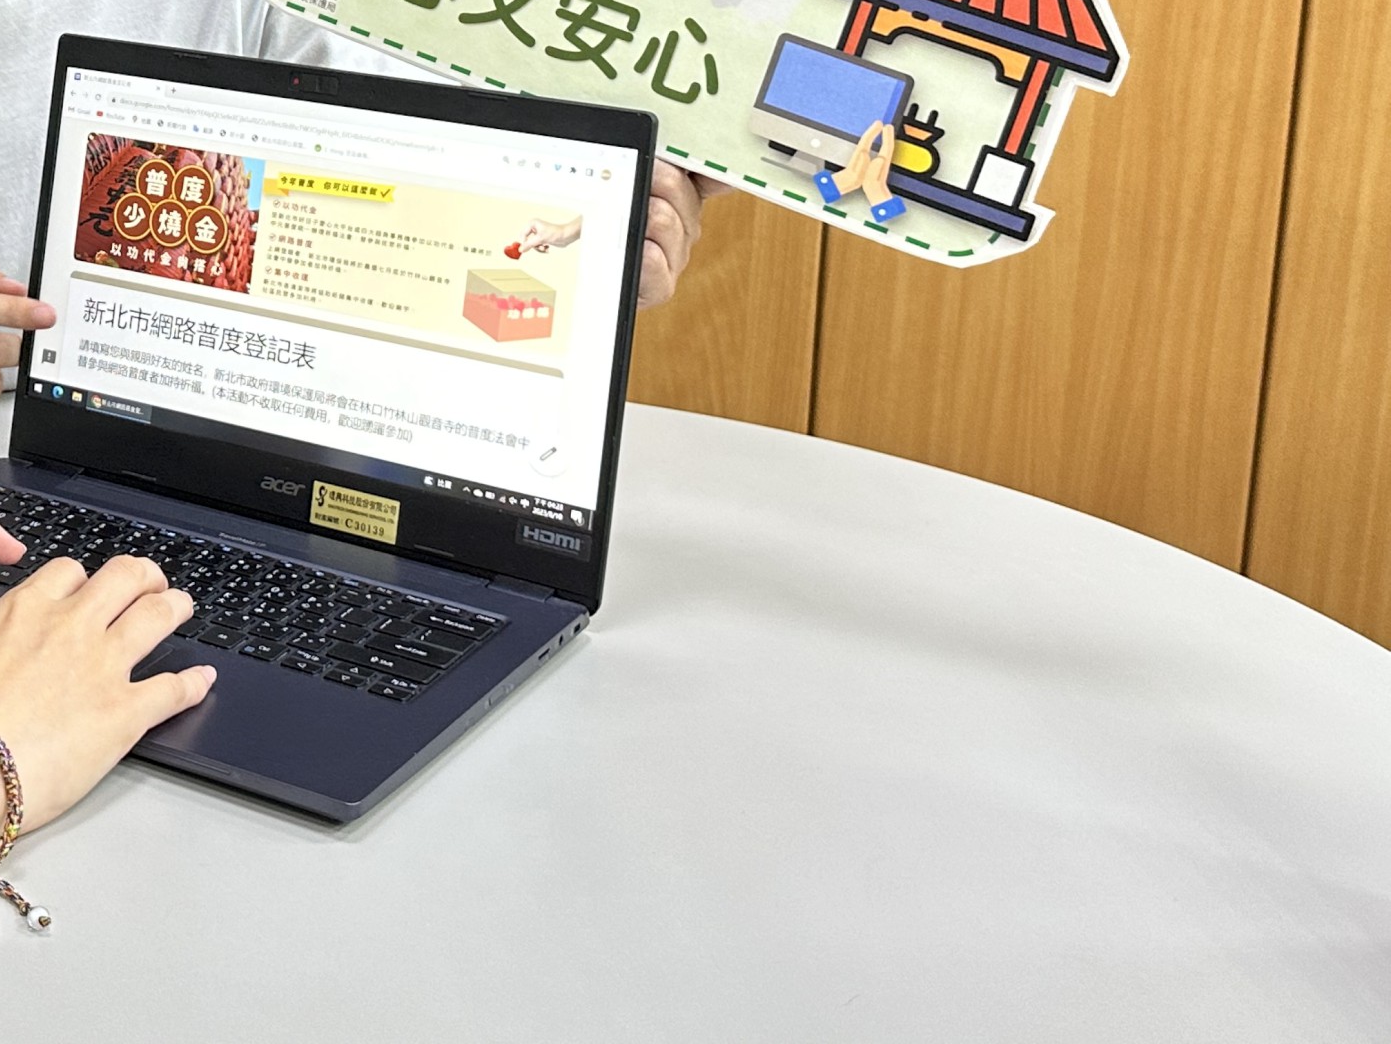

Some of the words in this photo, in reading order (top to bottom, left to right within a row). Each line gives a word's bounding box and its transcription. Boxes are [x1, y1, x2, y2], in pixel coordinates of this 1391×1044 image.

[145, 168, 206, 204] 普度
[123, 202, 219, 245] 少燒金
[83, 297, 317, 370] 新北市網路普度登記表
[260, 476, 306, 496] acer
[523, 525, 582, 552] HDMI
